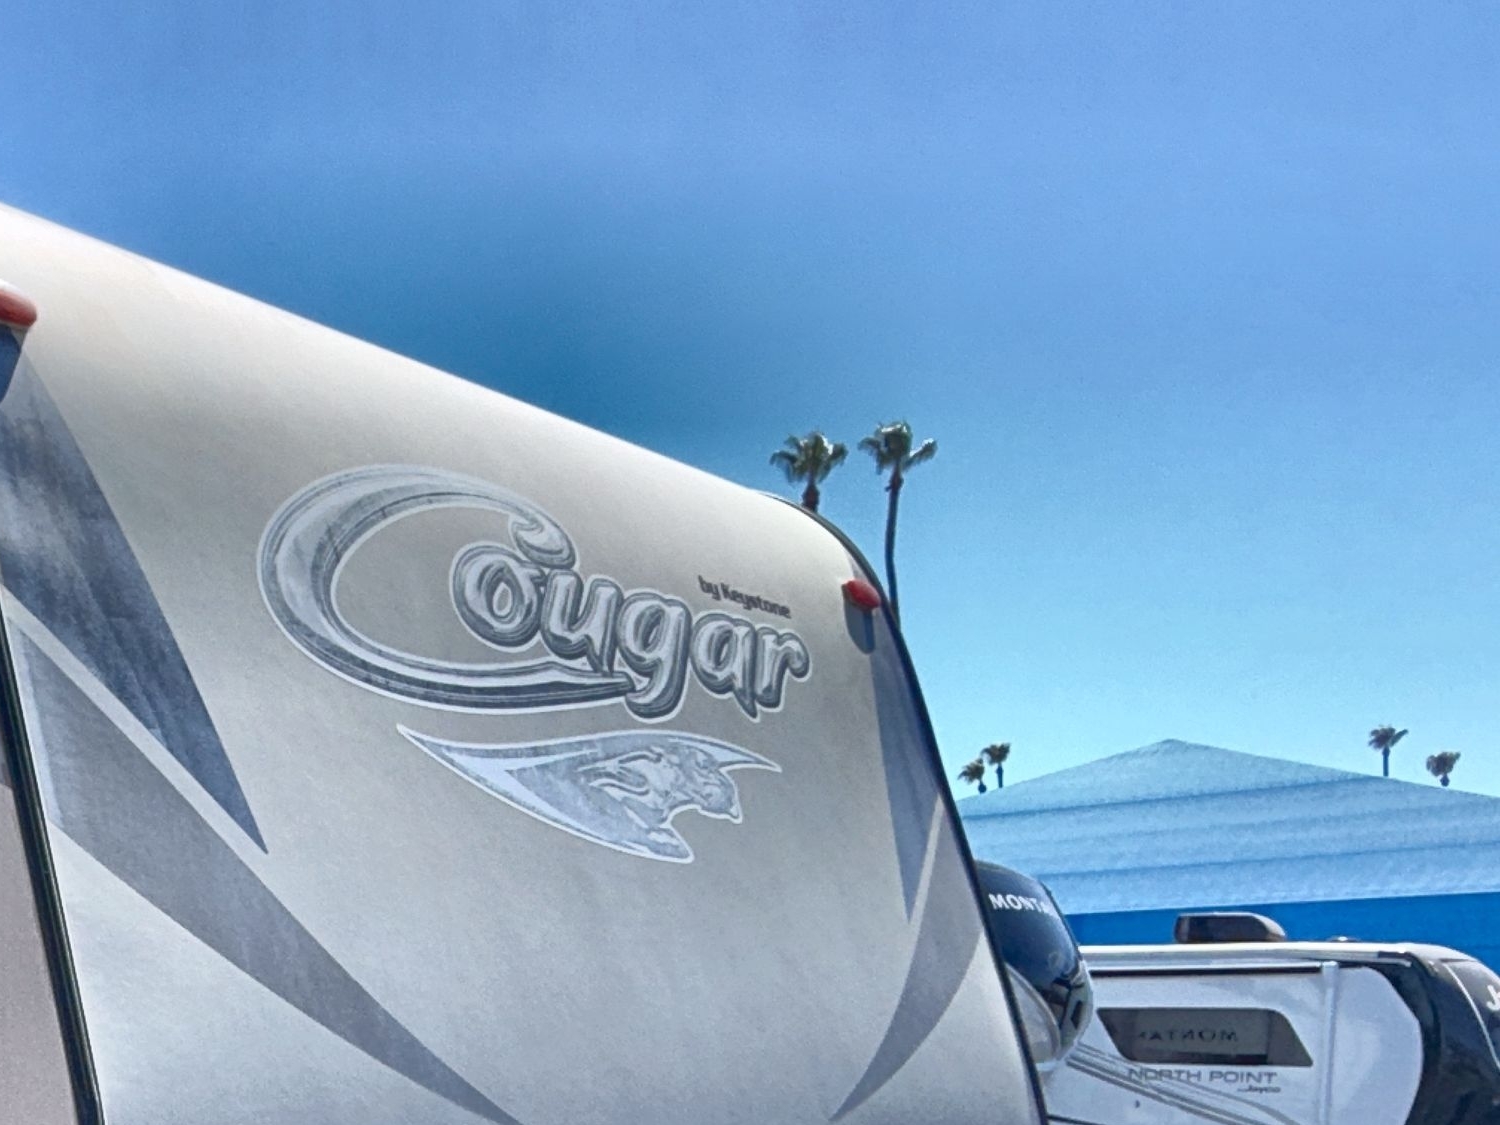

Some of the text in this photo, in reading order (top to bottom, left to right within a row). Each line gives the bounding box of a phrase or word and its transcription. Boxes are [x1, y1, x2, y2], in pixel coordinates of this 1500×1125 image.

[258, 464, 810, 722] Cougar
[698, 575, 720, 601] by
[1128, 1067, 1277, 1084] NORTH POINT
